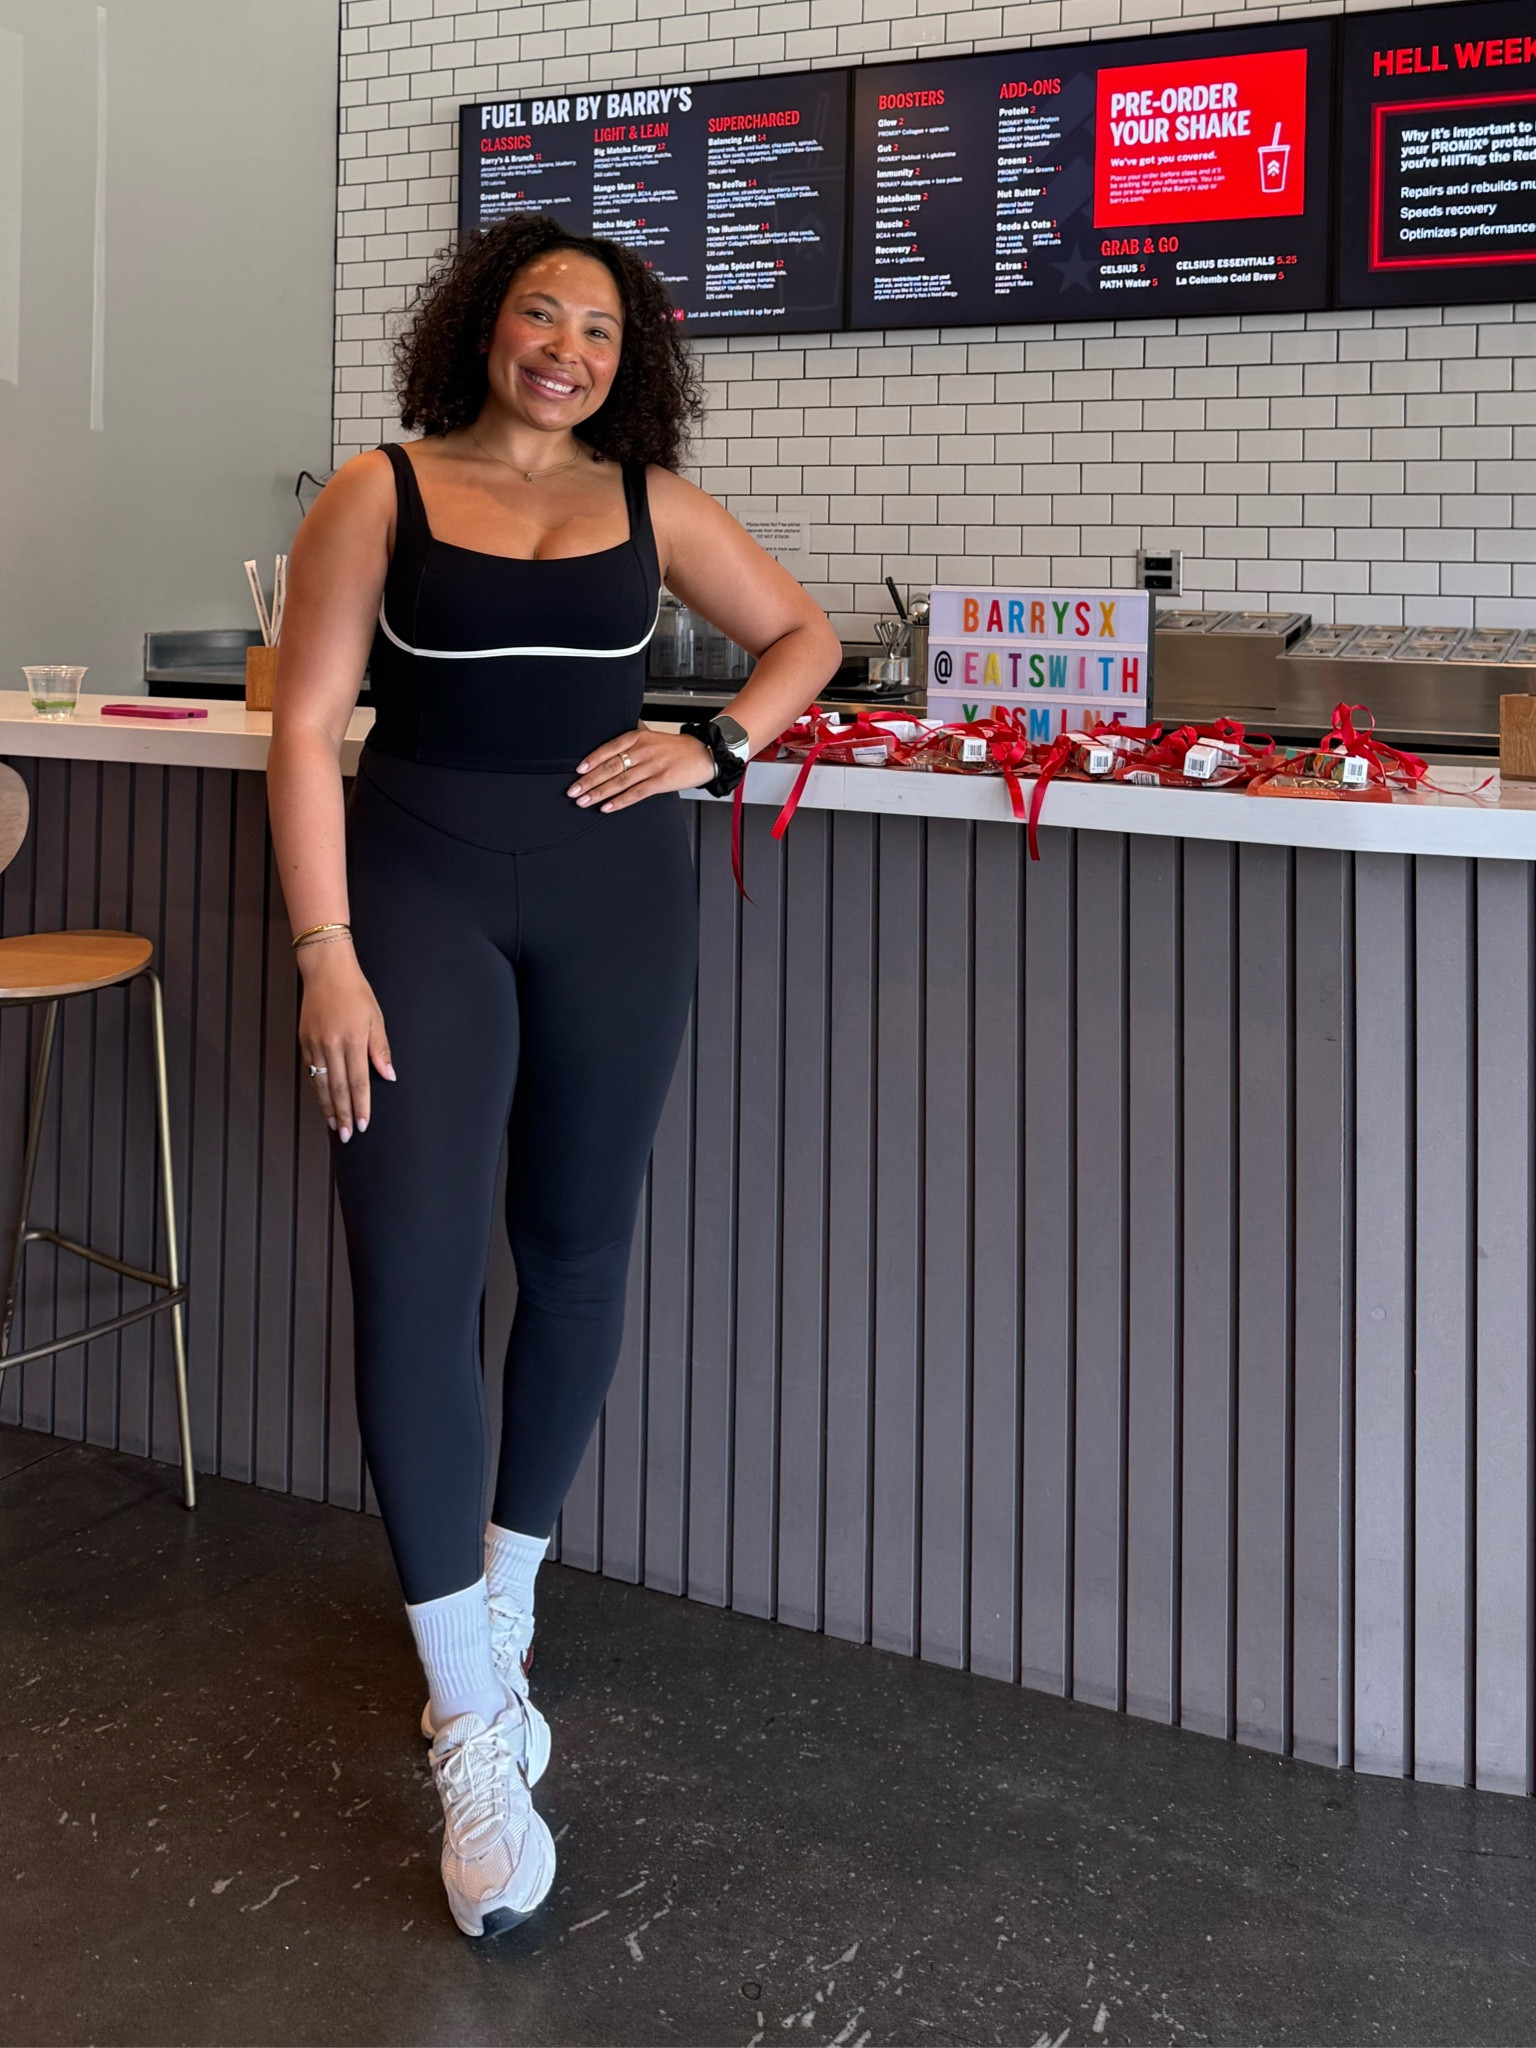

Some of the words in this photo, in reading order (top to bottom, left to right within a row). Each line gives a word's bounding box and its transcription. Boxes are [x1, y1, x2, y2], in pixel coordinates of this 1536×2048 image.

[1373, 46, 1448, 77] HELL
[1454, 37, 1536, 68] WEEK
[1000, 78, 1061, 99] ADD-ONS
[879, 89, 944, 110] BOOSTERS
[1111, 82, 1238, 118] PRE-ORDER
[481, 103, 526, 130] FUEL
[531, 99, 570, 125] BAR
[575, 95, 602, 121] BY
[606, 86, 692, 118] BARRY'S
[999, 107, 1028, 116] Protein
[708, 110, 800, 133] SUPERCHARGED
[878, 119, 897, 127] Glow
[594, 126, 626, 142] LIGHT
[629, 125, 637, 139] &
[641, 122, 668, 138] LEAN
[1110, 118, 1169, 146] YOUR
[1175, 110, 1251, 141] SHAKE
[1402, 130, 1428, 143] Why
[1453, 122, 1515, 138] important
[1518, 121, 1532, 132] to
[480, 134, 532, 152] CLASSICS
[708, 136, 742, 146] Balancing
[1401, 144, 1429, 158] your
[1492, 135, 1536, 151] protein
[594, 148, 605, 156] Big
[607, 146, 631, 154] Matcha
[633, 145, 656, 153] Energy
[877, 144, 892, 153] Gut
[481, 157, 503, 165] Barry's
[511, 154, 534, 162] Brunch
[998, 157, 1026, 165] Greens
[1111, 157, 1137, 167] We've
[1139, 155, 1155, 167] got
[1157, 154, 1174, 165] you
[1177, 150, 1217, 162] covered.
[1401, 157, 1438, 172] you're
[1489, 151, 1510, 163] the
[1513, 149, 1536, 161] Red
[877, 169, 913, 178] Immunity
[593, 185, 616, 193] Mango
[708, 182, 720, 190] The
[748, 179, 757, 187] 14
[1401, 186, 1444, 199] Repairs
[1446, 183, 1468, 195] and
[1471, 179, 1518, 193] rebuilds
[997, 190, 1012, 198] Nut
[1014, 188, 1041, 197] Butter
[1042, 187, 1047, 195] 1
[877, 194, 921, 203] Metabolism
[1400, 207, 1443, 220] Speeds
[1446, 204, 1497, 216] recovery
[593, 221, 615, 229] Mocha
[616, 220, 636, 228] Magic
[706, 226, 720, 234] The
[722, 224, 759, 233] Illuminator
[876, 220, 903, 229] Muscle
[905, 219, 910, 227] 2
[996, 222, 1021, 231] Seeds
[1023, 221, 1029, 229] &
[1031, 221, 1051, 229] Oats
[1400, 227, 1457, 241] Optimizes
[1460, 224, 1536, 239] performance
[875, 246, 910, 254] Recovery
[1101, 238, 1139, 256] GRAB
[1143, 238, 1154, 253] &
[1158, 236, 1179, 253] GO
[706, 263, 729, 271] Vanilla
[731, 262, 754, 271] Spiced
[756, 261, 774, 269] Brew
[776, 260, 784, 268] 12
[996, 262, 1021, 271] Extras
[1176, 260, 1215, 270] CELSIUS
[1217, 256, 1275, 268] ESSENTIALS
[1277, 256, 1297, 264] 5.25
[1100, 265, 1138, 275] CELSIUS
[1140, 264, 1146, 272] 5
[1100, 279, 1123, 289] PATH
[1125, 279, 1150, 288] Water
[1152, 278, 1158, 287] 5
[1176, 277, 1187, 285] La
[1189, 274, 1228, 284] Colombe
[1230, 272, 1251, 282] Cold
[1253, 272, 1276, 281] Brew
[773, 307, 785, 315] you!
[934, 651, 1138, 693] @EATSWITH
